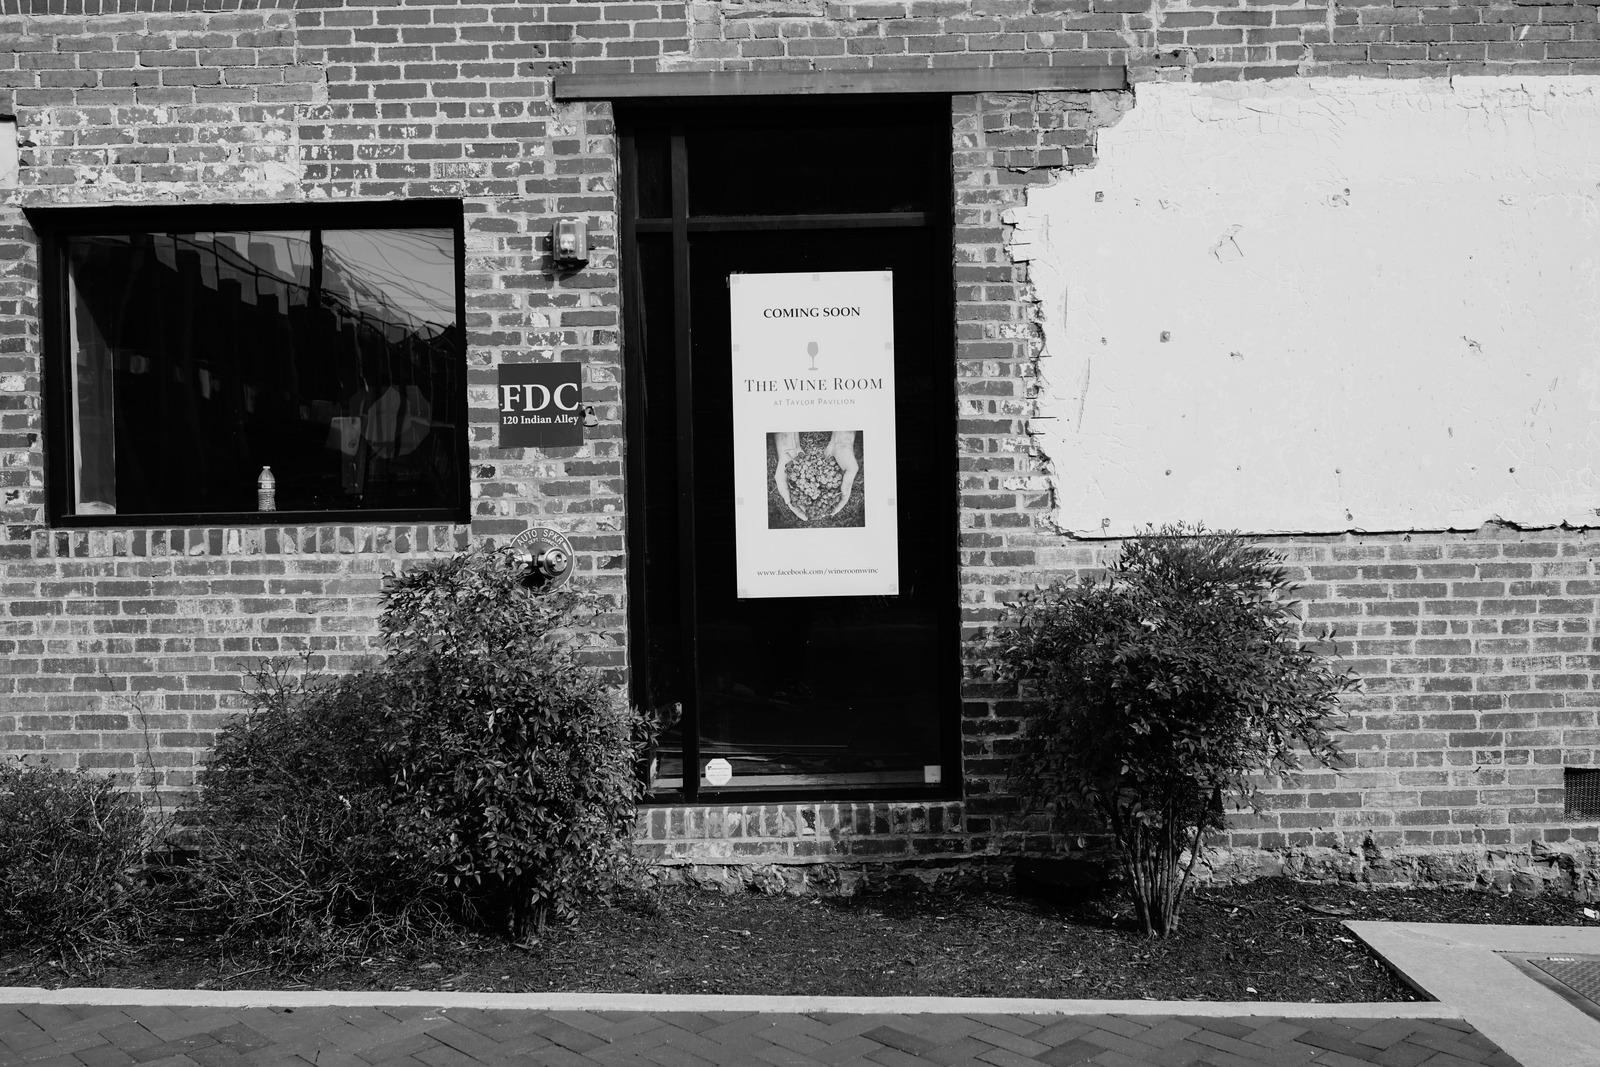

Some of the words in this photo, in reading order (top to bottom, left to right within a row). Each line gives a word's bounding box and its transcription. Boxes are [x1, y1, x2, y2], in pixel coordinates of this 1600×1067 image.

[763, 307, 820, 319] COMING
[822, 306, 861, 318] SOON
[500, 382, 580, 412] FDC
[502, 416, 519, 425] 120
[520, 414, 552, 424] Indian
[553, 414, 579, 425] Alley
[517, 529, 538, 546] AUTO
[542, 529, 564, 545] SPKR
